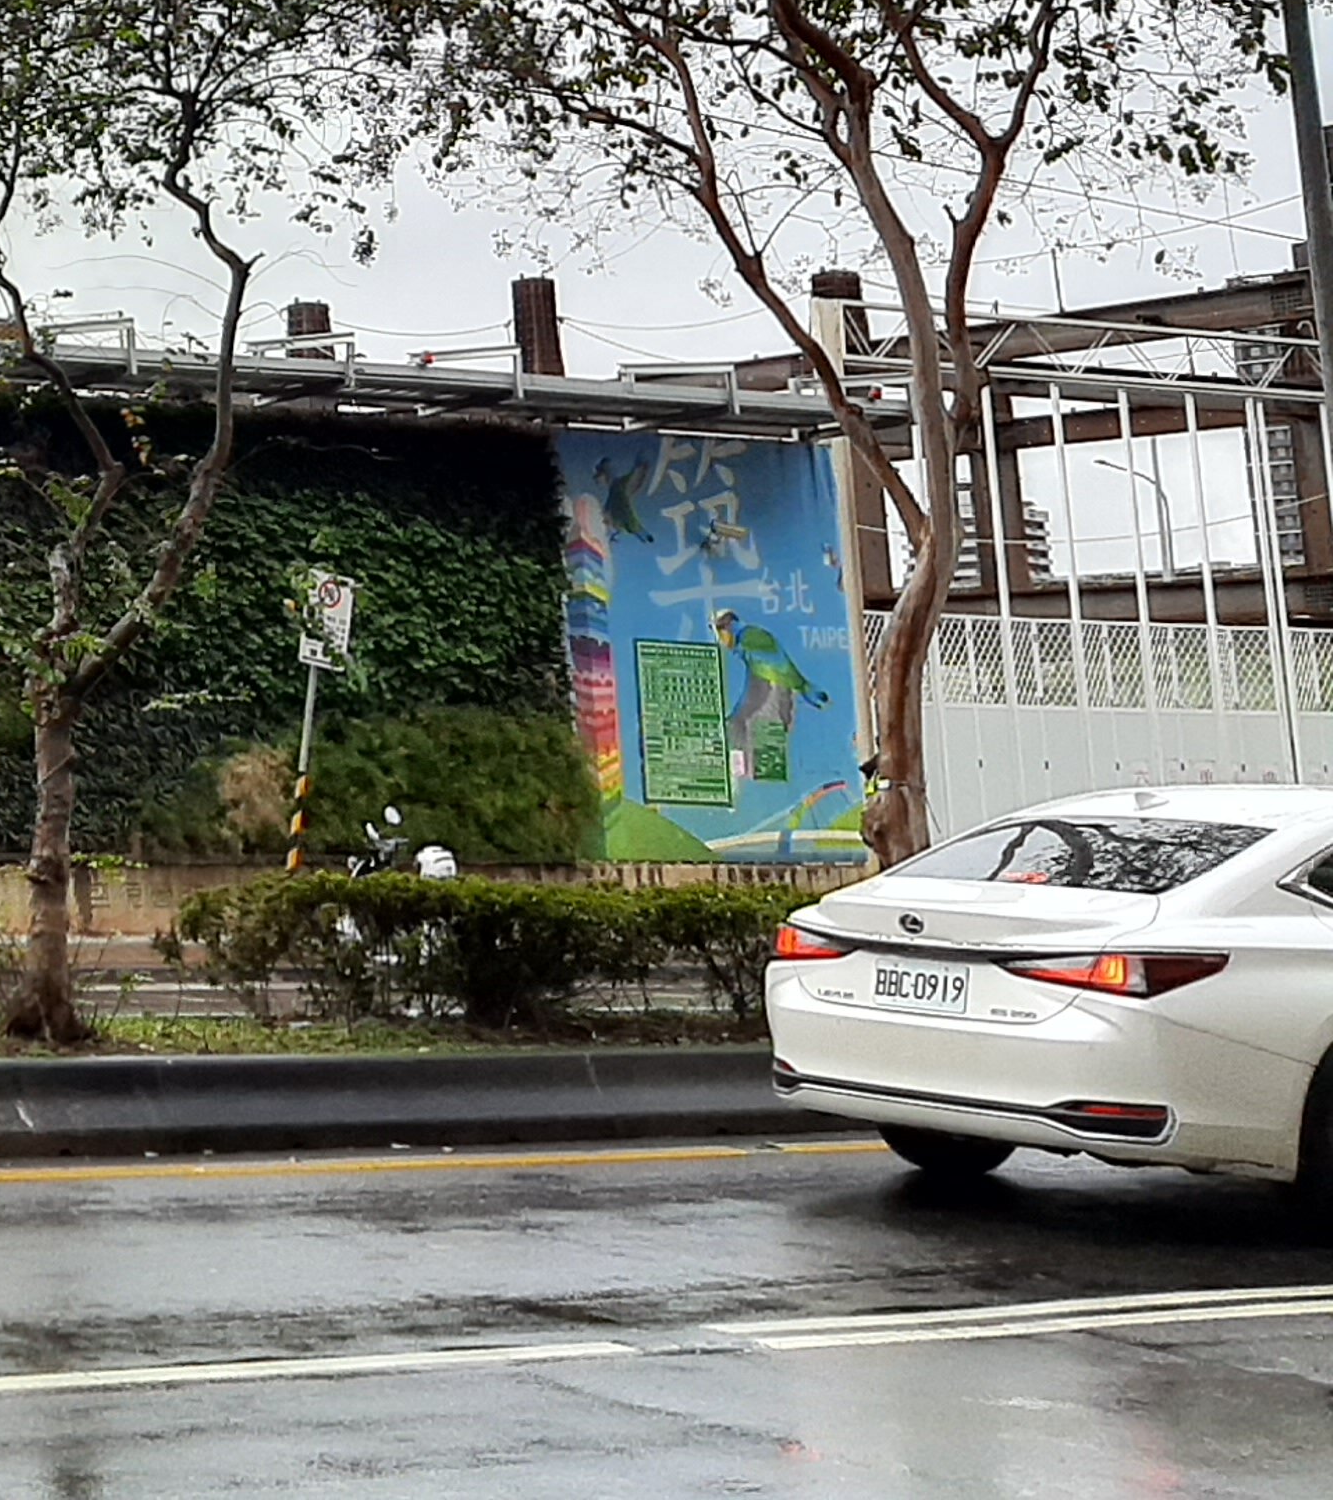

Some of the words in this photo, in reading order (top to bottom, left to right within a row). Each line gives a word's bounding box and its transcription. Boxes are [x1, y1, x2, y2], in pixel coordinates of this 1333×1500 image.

[758, 566, 815, 615] 台北
[796, 625, 850, 651] TAIPE
[873, 967, 966, 1004] BBC-0919
